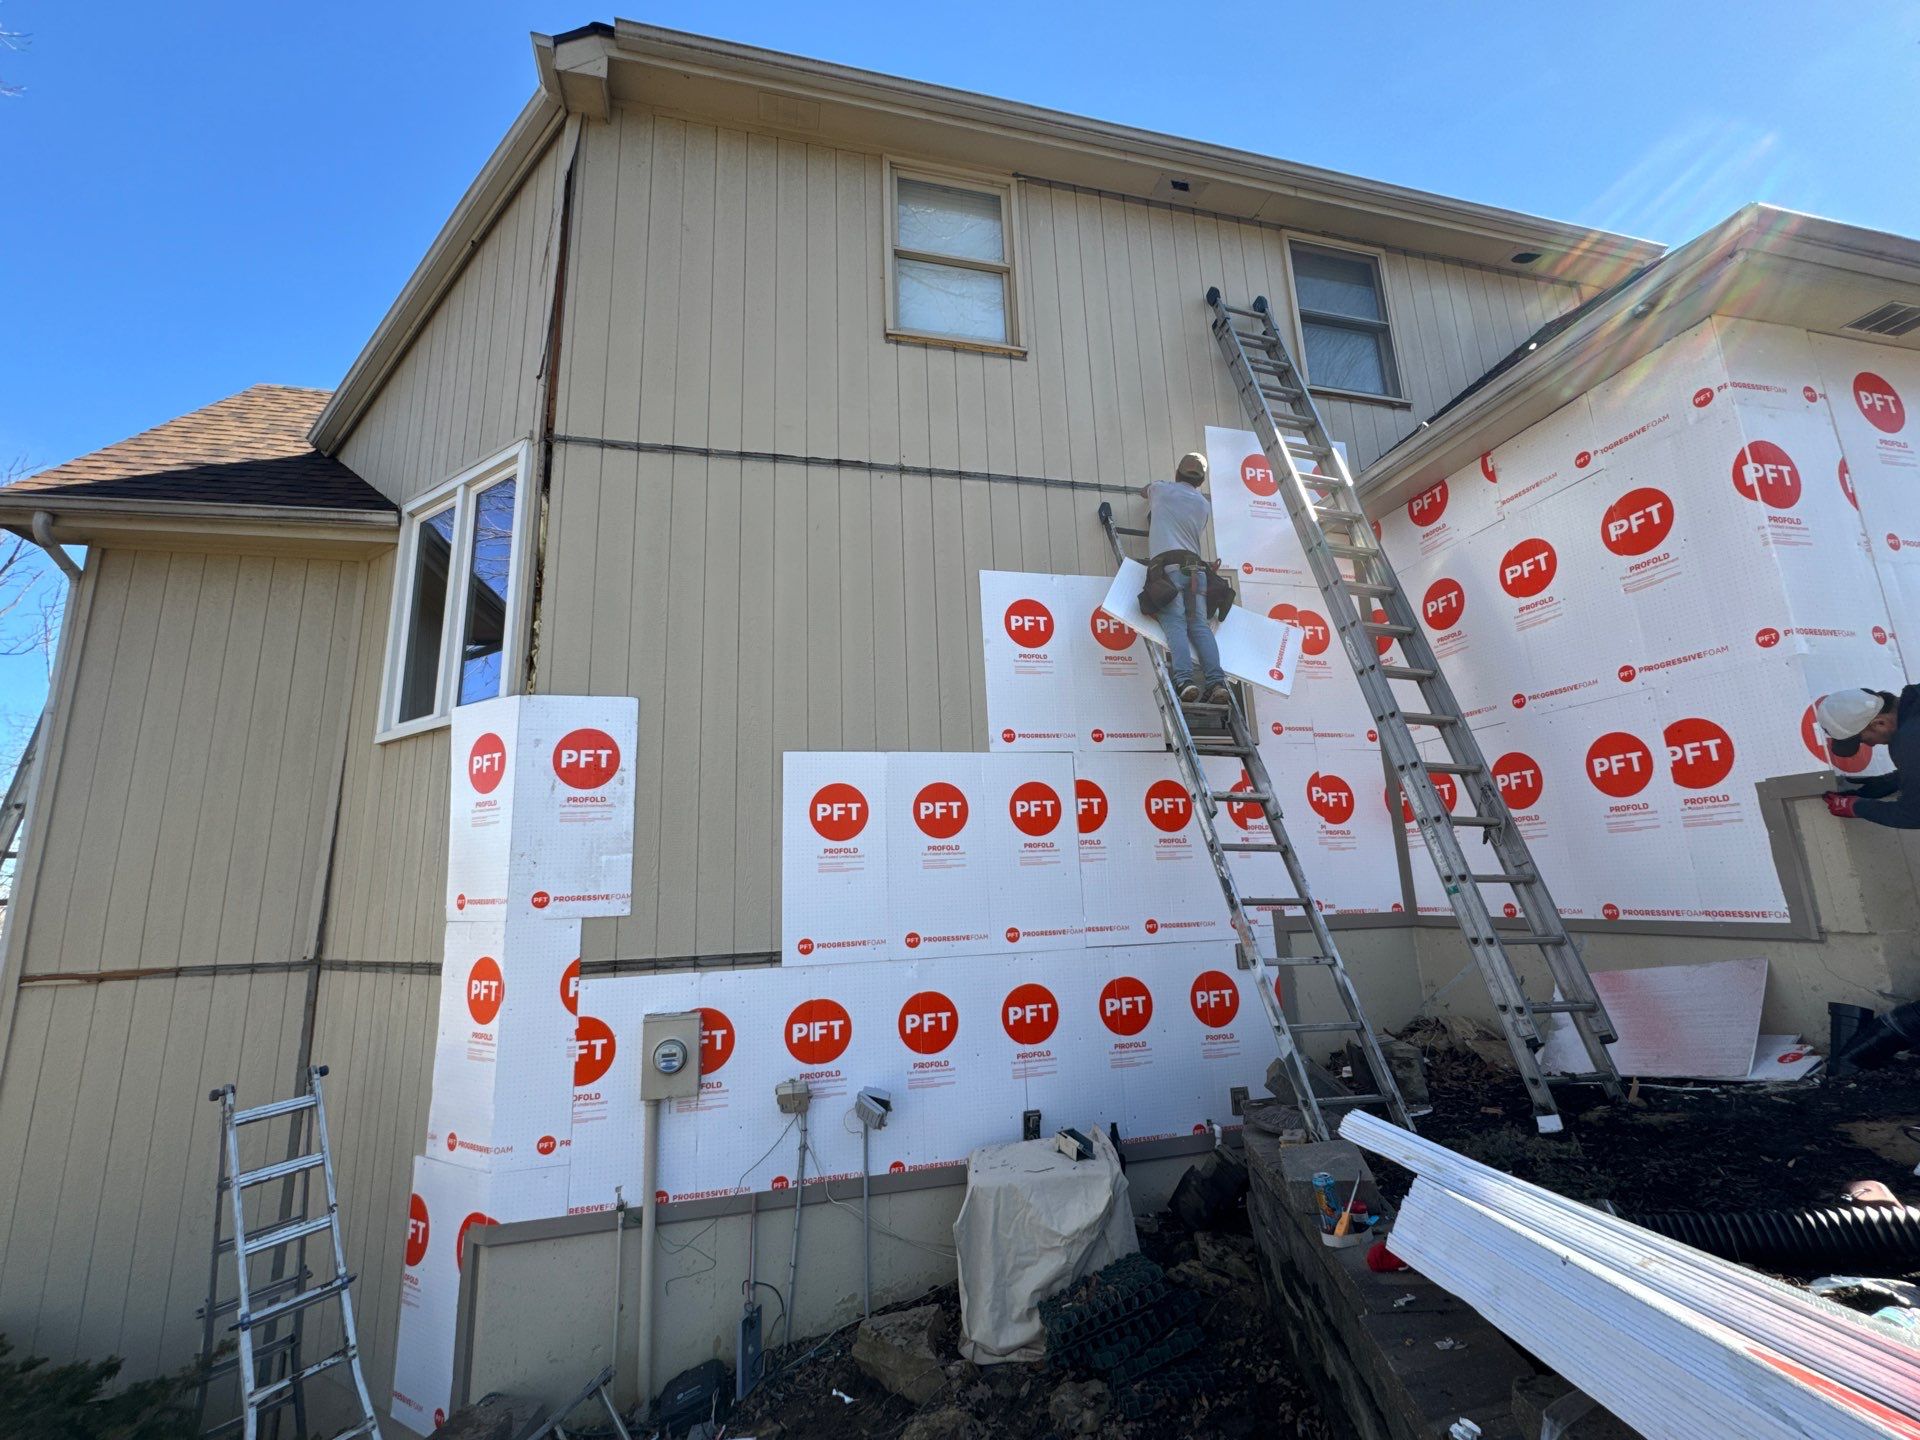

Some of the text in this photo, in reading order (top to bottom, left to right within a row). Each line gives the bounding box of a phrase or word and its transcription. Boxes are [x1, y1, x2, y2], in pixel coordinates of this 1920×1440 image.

[1695, 391, 1712, 404] PFT
[1859, 390, 1897, 414] PFT
[1879, 438, 1908, 449] PROFOLD
[1576, 455, 1590, 465] PFT
[1501, 472, 1558, 506] ROGRESSIVEFOAM
[1412, 485, 1443, 516] PFT
[1608, 502, 1663, 542] PFT
[1768, 515, 1802, 525] PROFOLD
[1505, 551, 1549, 585] PFT
[1629, 552, 1670, 573] PROFOLD
[1427, 591, 1458, 618] PFT
[1010, 615, 1048, 632] PFT
[1303, 625, 1324, 640] FT
[1436, 630, 1463, 644] PROFOLD
[1758, 633, 1776, 643] PFT
[1619, 670, 1635, 678] PFT
[561, 749, 612, 769] PFT
[1668, 738, 1722, 767] PFT
[473, 752, 502, 775] PFT
[1592, 751, 1643, 778] PFT
[1496, 769, 1535, 792] PFT
[567, 796, 607, 804] PROFOLD
[1078, 798, 1102, 815] FT
[1151, 798, 1186, 815] PFT
[1683, 794, 1730, 806] PROFOLD
[816, 803, 862, 822] PFT
[920, 802, 961, 820] PFT
[1016, 800, 1055, 818] PFT
[1609, 803, 1649, 813] PROFOLD
[1513, 814, 1540, 823] ROFOLD
[533, 893, 632, 904] PFT PROGRESSIVEFOAM
[1603, 908, 1618, 916] PFT
[1704, 910, 1789, 919] ROGRESSIVEFOA
[1022, 928, 1084, 937] PROGRESSIVEFOAM
[1086, 925, 1130, 933] RESSIVEFOAM
[1160, 921, 1216, 929] PROGRESSIVEFOAM
[800, 939, 887, 951] PFT PROGRESSIVEFOAM
[907, 934, 989, 945] PFT PROGRESSIVEFOAM
[471, 980, 498, 1001] PFT
[1105, 996, 1146, 1017] PFT
[1196, 989, 1233, 1009] PFT
[905, 1011, 951, 1034] PFT
[1008, 1004, 1052, 1026] PFT
[472, 1031, 493, 1041] PROFOLD
[700, 1029, 727, 1051] FT
[1205, 1033, 1235, 1041] PROFOLD
[575, 1038, 608, 1062] FT
[701, 1081, 723, 1090] FOLD
[573, 1093, 601, 1102] OFOLD
[538, 1141, 555, 1150] PFT
[672, 1186, 751, 1201] PROGRESSIVEFOAM
[569, 1202, 617, 1215] RESSIVEFO
[408, 1219, 426, 1244] FT
